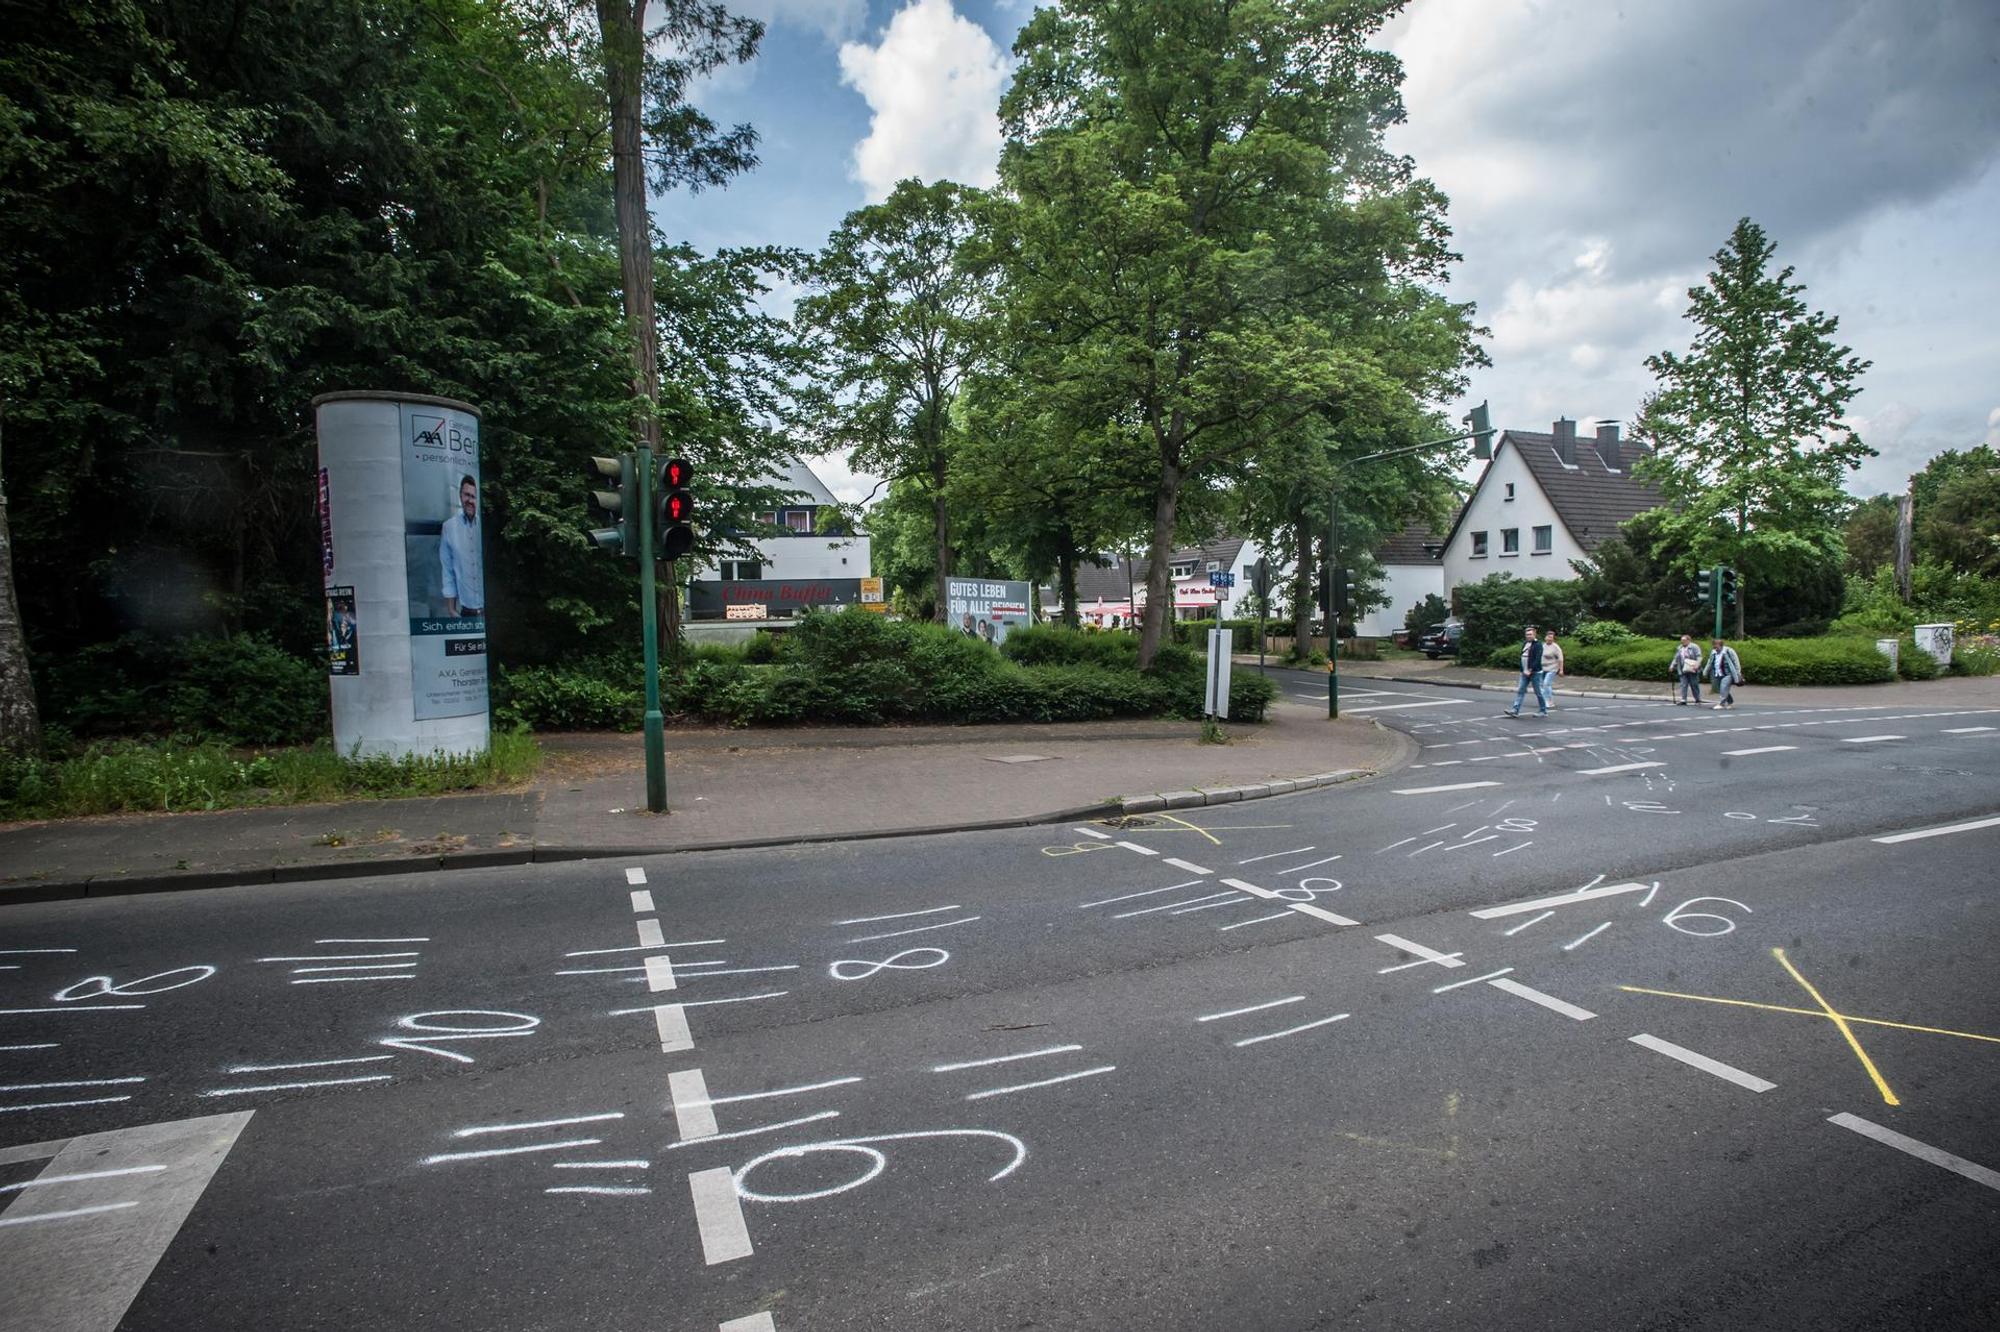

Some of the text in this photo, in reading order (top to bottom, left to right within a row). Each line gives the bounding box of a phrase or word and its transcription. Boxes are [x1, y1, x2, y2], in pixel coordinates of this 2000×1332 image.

[413, 430, 444, 446] AXA
[722, 583, 833, 603] China Buffet
[950, 582, 1006, 598] GUTES LEBEN
[950, 597, 967, 614] FÜR
[970, 600, 990, 614] ALLE
[422, 622, 444, 632] Sich
[446, 620, 473, 631] einfach
